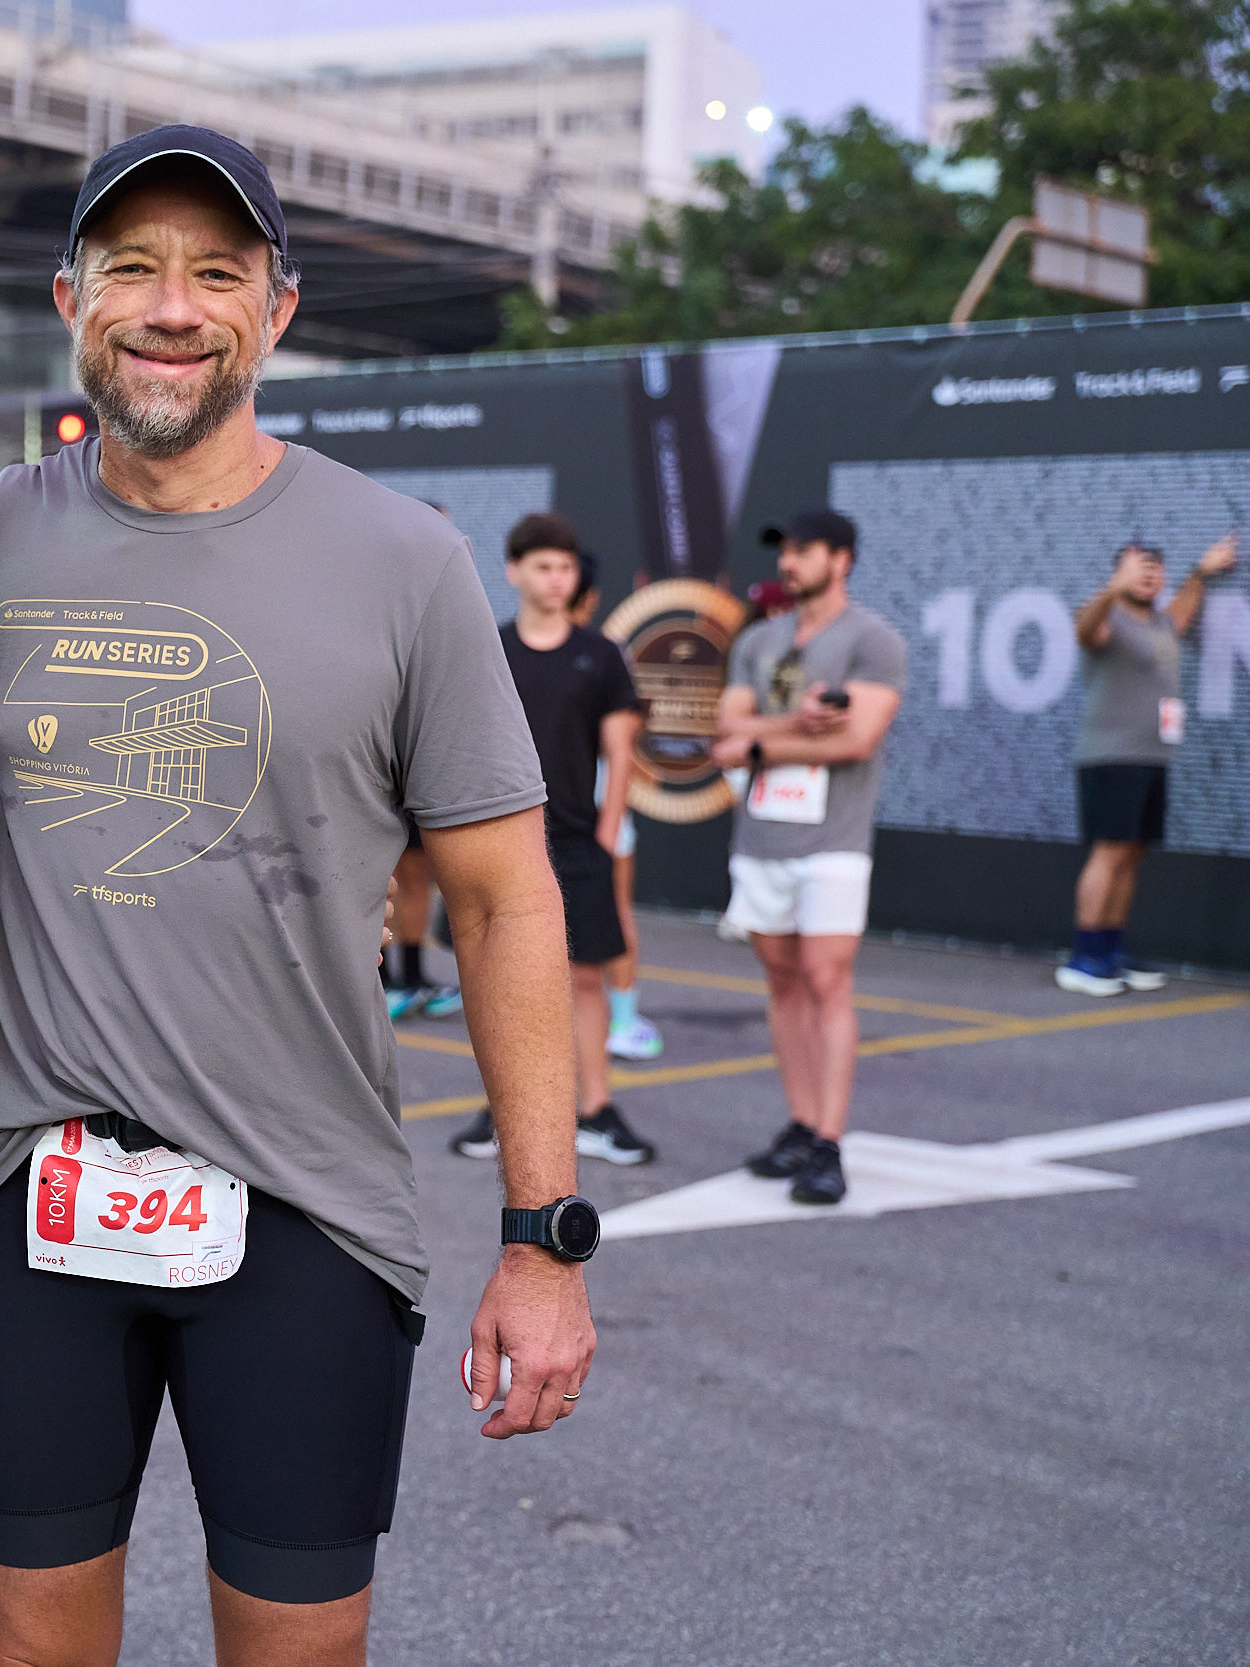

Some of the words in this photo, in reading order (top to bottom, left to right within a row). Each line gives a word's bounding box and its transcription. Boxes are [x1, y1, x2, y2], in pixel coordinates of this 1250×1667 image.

[14, 609, 54, 618] Santander
[9, 756, 51, 771] SHOPPING
[53, 763, 90, 776] VITÓRIA
[91, 885, 156, 908] tfsports
[48, 1168, 70, 1226] 10KM
[97, 1185, 208, 1235] 394
[35, 1253, 57, 1264] vivo
[169, 1257, 238, 1283] ROSNEY
